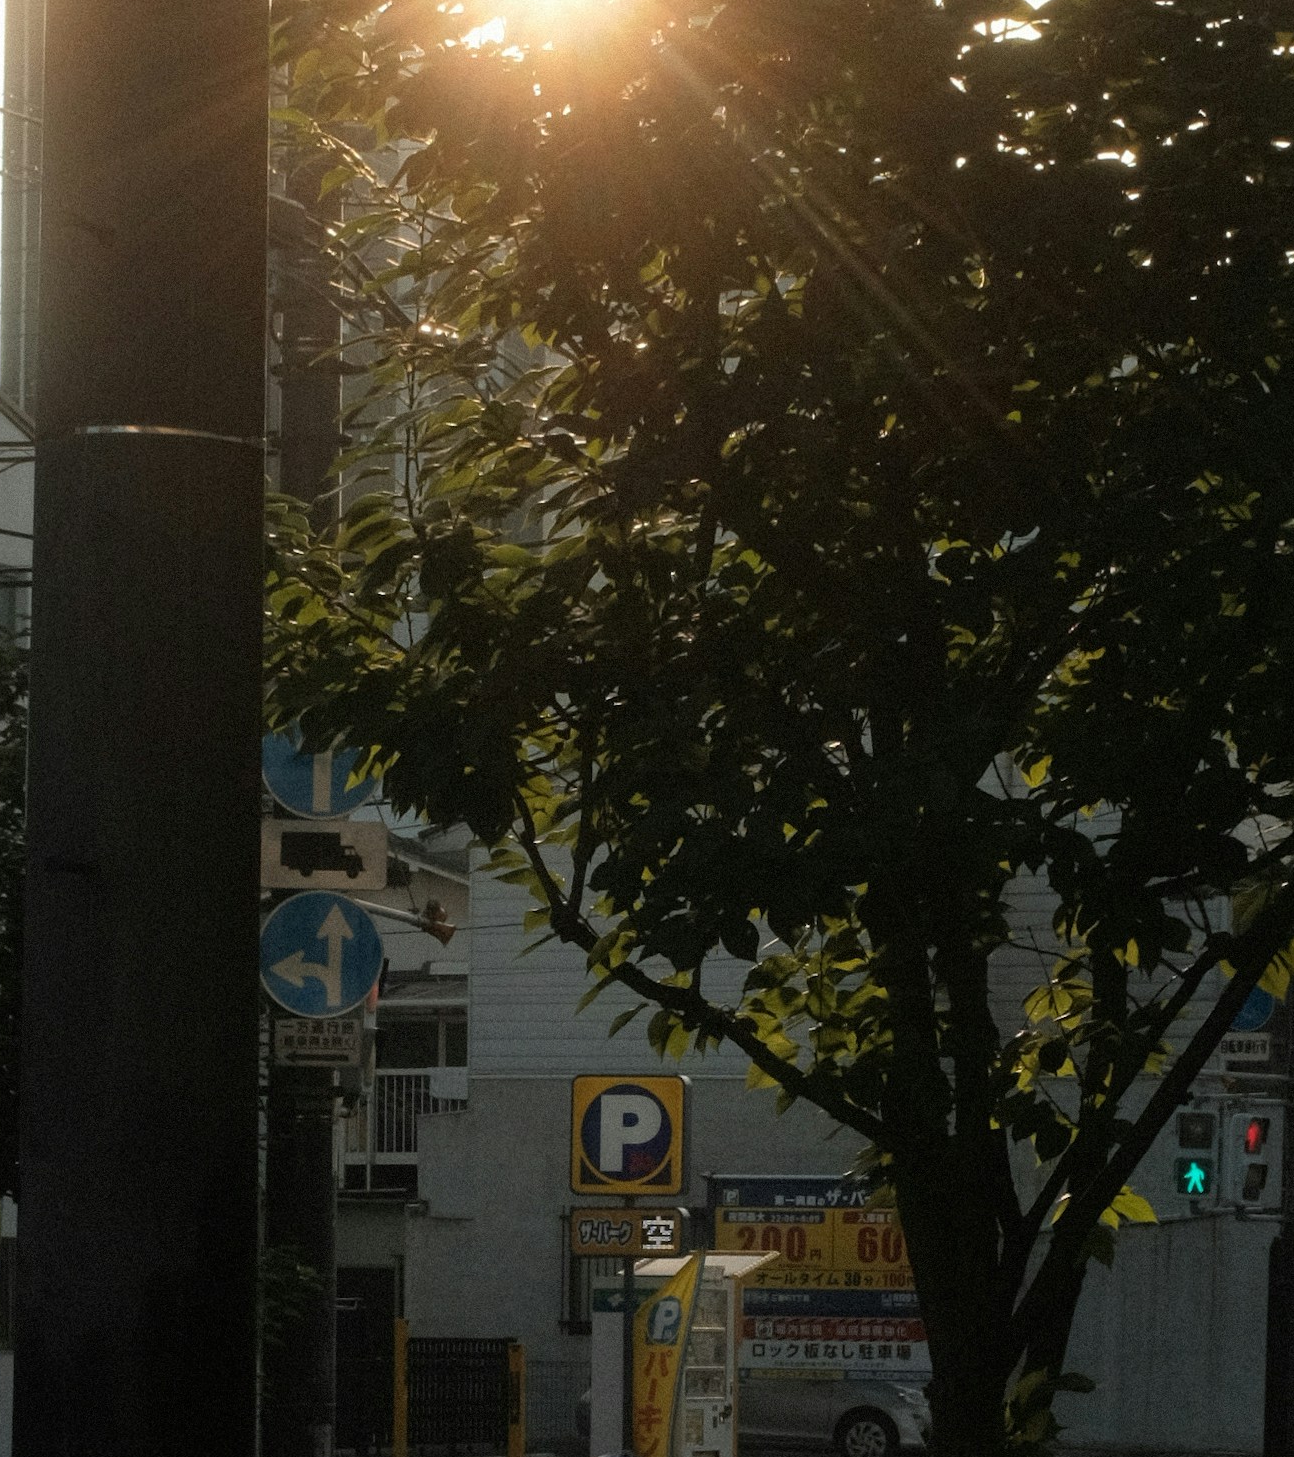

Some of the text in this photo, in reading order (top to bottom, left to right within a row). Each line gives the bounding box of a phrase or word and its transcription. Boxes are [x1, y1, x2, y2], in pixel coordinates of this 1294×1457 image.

[600, 1093, 661, 1171] P
[642, 1215, 676, 1250] 空
[756, 1273, 839, 1286] オールタイム
